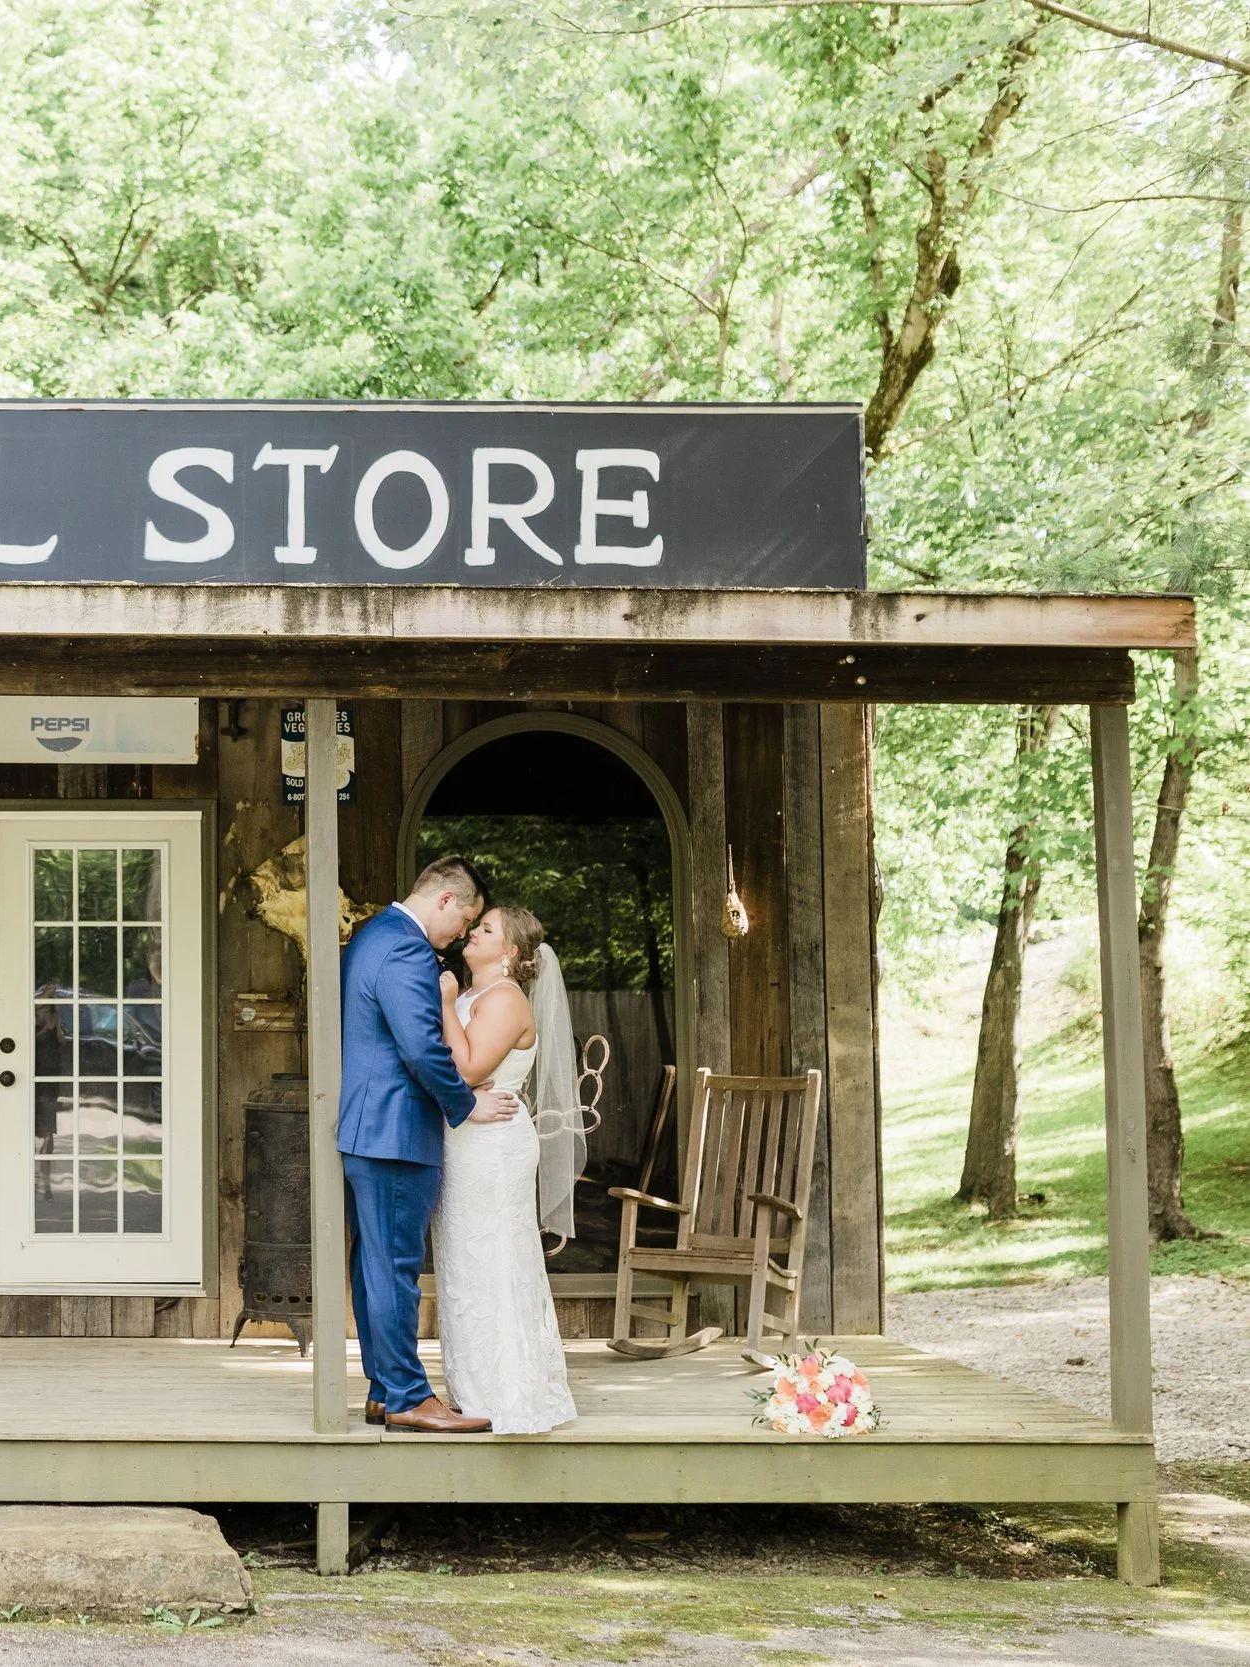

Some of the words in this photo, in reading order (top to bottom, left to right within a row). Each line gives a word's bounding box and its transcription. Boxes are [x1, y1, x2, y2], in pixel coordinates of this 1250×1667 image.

[144, 442, 662, 569] STORE
[30, 717, 90, 732] PEPSI
[285, 777, 304, 788] SOLD
